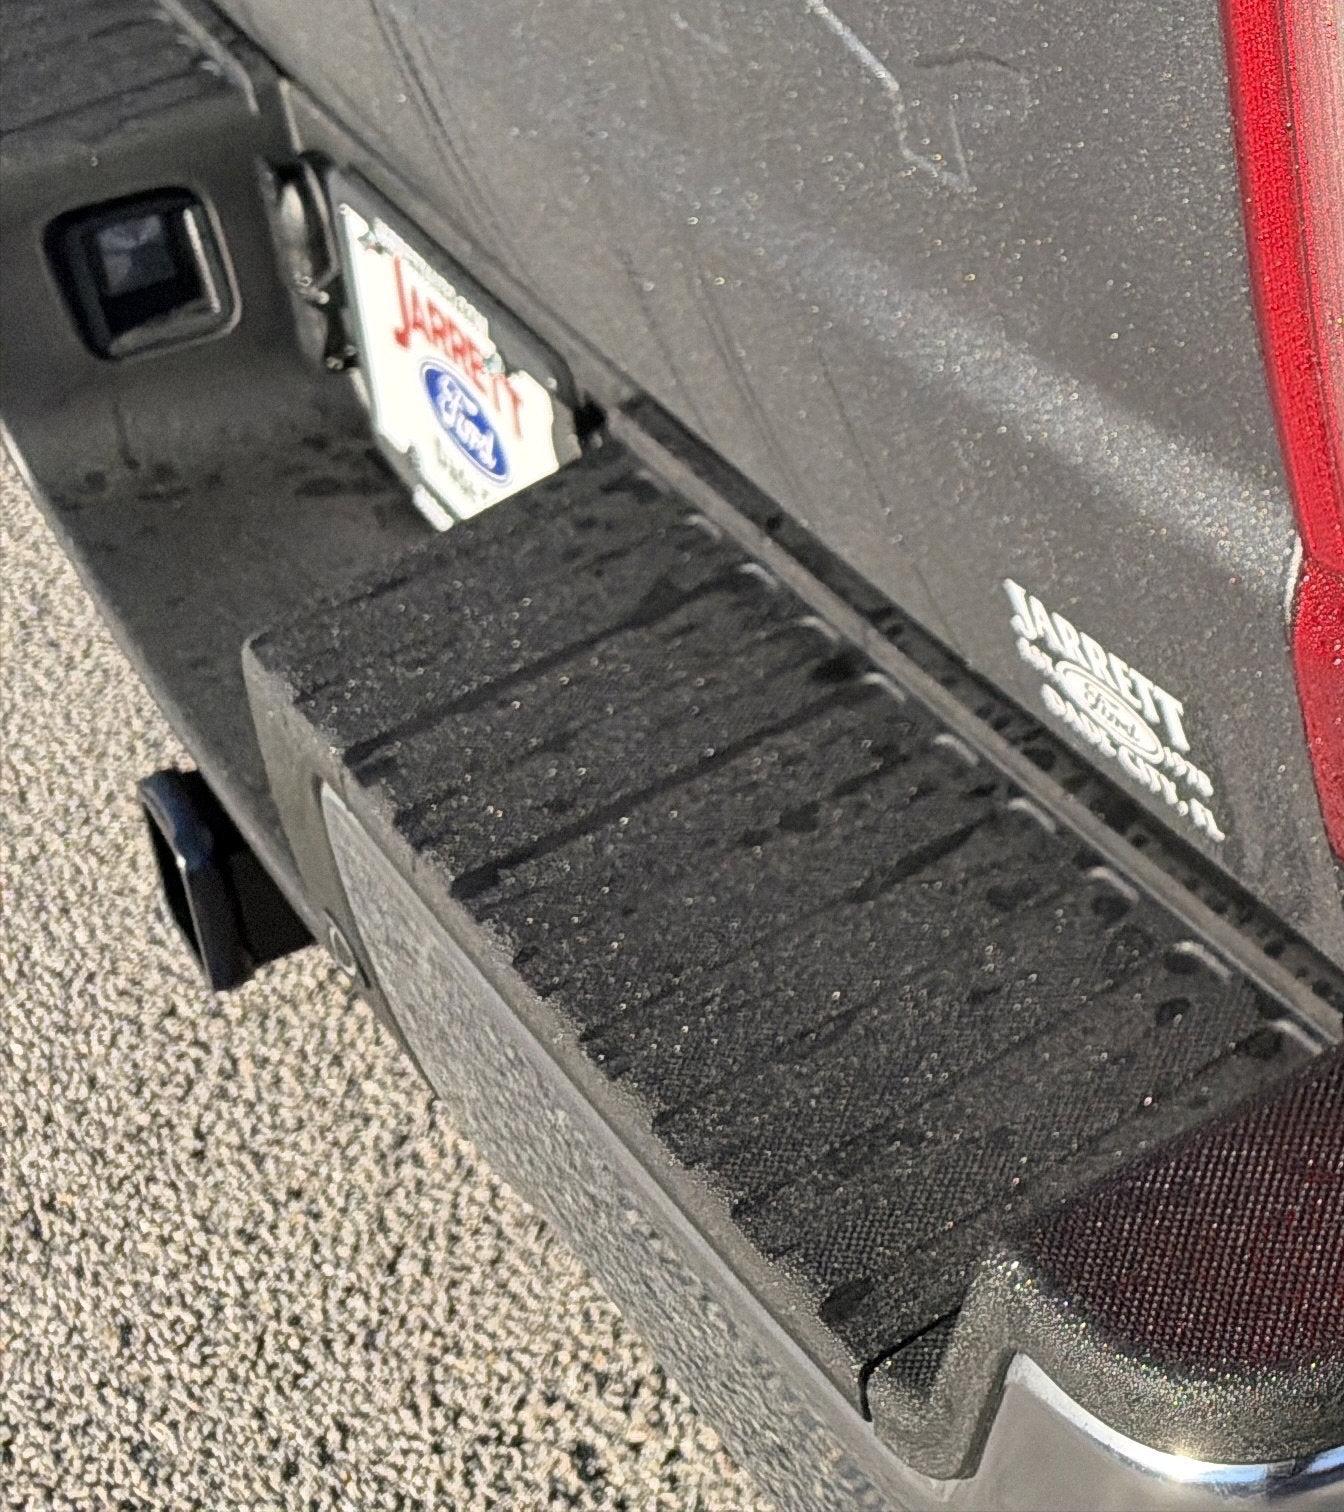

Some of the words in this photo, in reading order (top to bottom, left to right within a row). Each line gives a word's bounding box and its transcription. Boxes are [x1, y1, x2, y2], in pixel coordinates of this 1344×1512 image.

[393, 252, 525, 441] JARRETT
[434, 372, 502, 471] Ford
[1003, 578, 1191, 752] JARRETT
